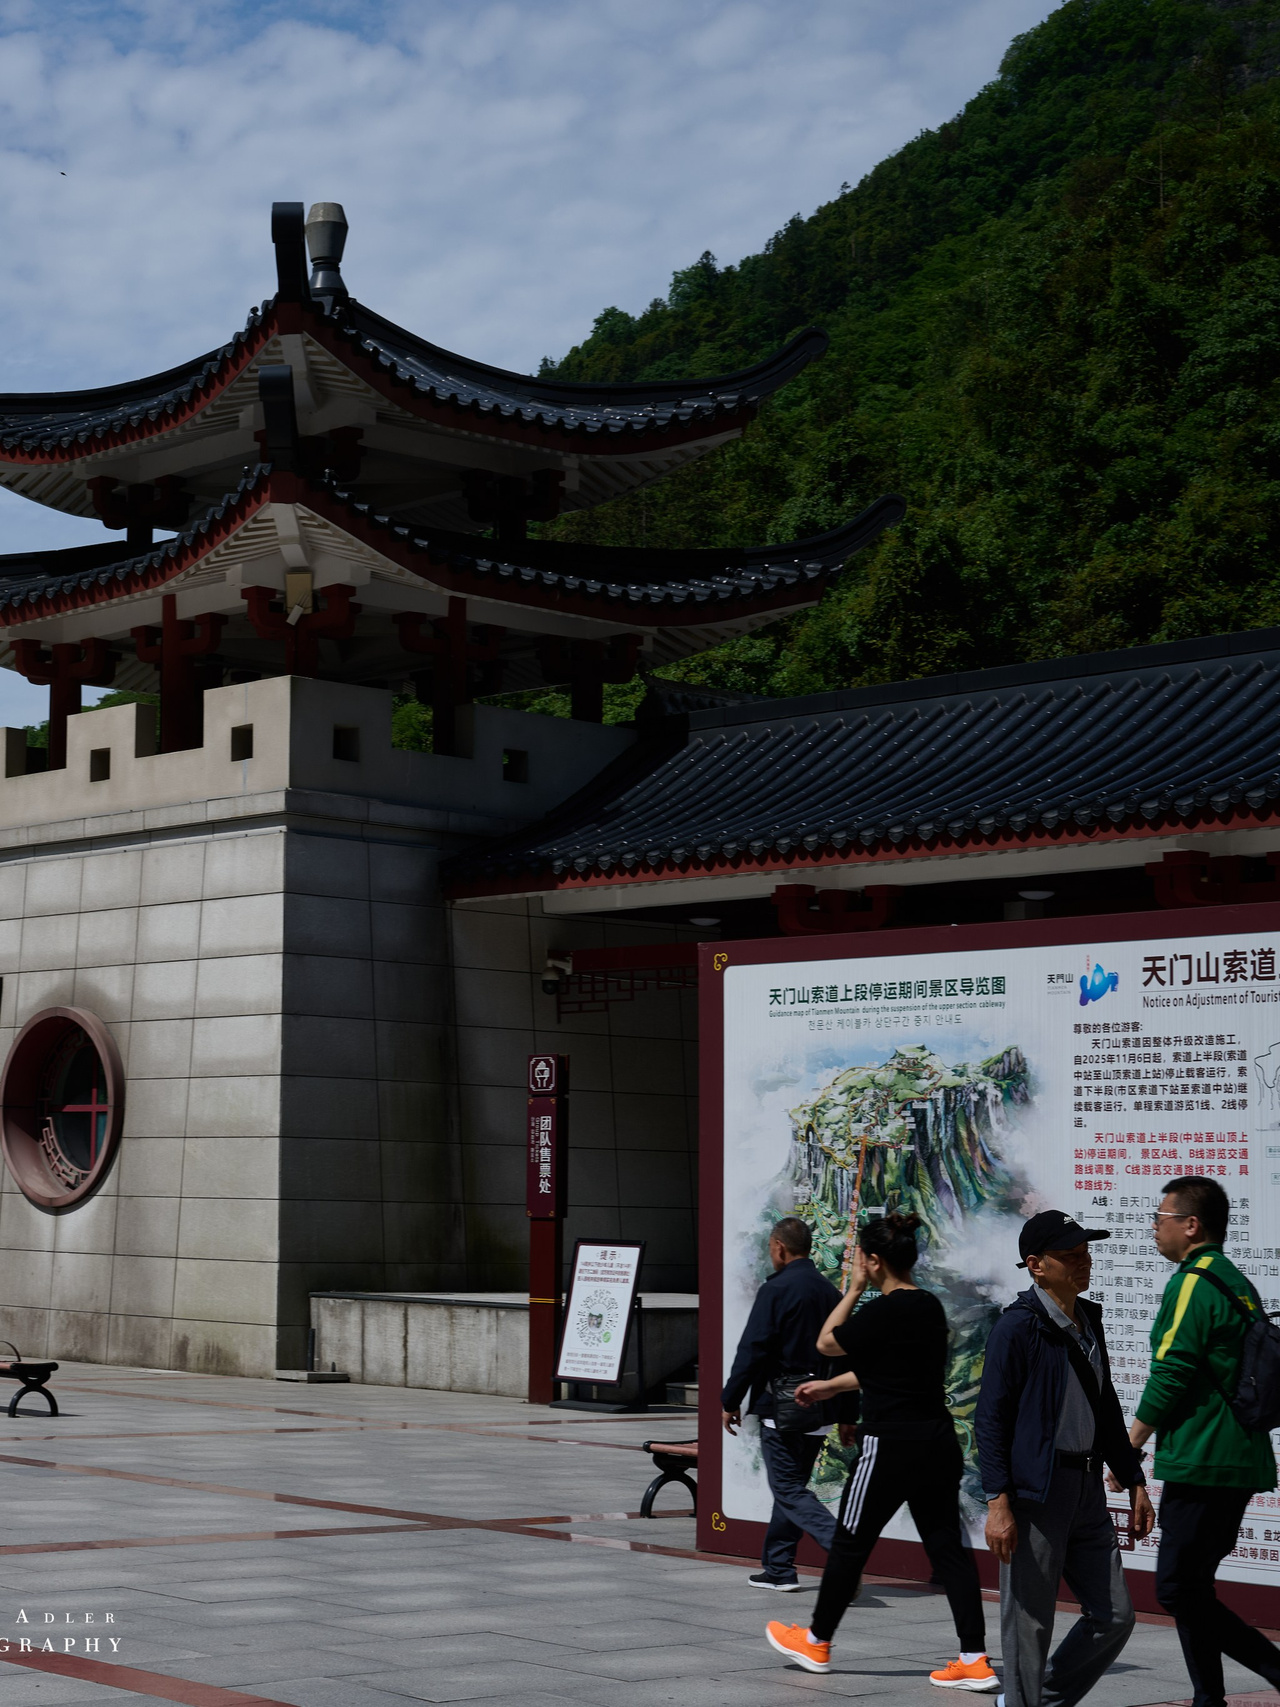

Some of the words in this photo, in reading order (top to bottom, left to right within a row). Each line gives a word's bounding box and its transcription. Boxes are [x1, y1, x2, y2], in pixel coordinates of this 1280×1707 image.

[1142, 948, 1276, 987] 天门山索道
[1047, 973, 1074, 984] 天門山
[769, 976, 1006, 1006] 天门山索道上段停运期间景区导览图
[1143, 995, 1171, 1008] Notice
[1173, 997, 1184, 1007] on
[1185, 992, 1237, 1009] Adjustment
[1239, 990, 1249, 1004] of
[769, 1009, 792, 1018] Guidance
[793, 1010, 804, 1018] map
[805, 1008, 811, 1016] of
[811, 1007, 833, 1015] Tianmen
[835, 1006, 860, 1014] Mountain
[862, 1005, 880, 1014] during
[880, 1004, 890, 1012] the
[890, 1003, 921, 1013] suspension
[922, 1002, 928, 1010] of
[928, 1002, 938, 1010] the
[939, 1003, 956, 1011] upper
[956, 1001, 977, 1009] section
[979, 1000, 1006, 1009] cableway
[837, 1018, 871, 1030] 케이블카
[875, 1016, 910, 1028] 상단구간
[915, 1015, 931, 1026] 중지
[936, 1014, 963, 1025] 안내도
[1092, 1034, 1241, 1049] 天门山索道因整体升级改造施工，
[1074, 1082, 1248, 1097] 道下半段(市区索道下站至索道中站)继
[1074, 1117, 1088, 1128] 运。
[1094, 1132, 1249, 1144] 天门山索道上半段(中站至山顶上
[538, 1115, 552, 1194] 团队售票处
